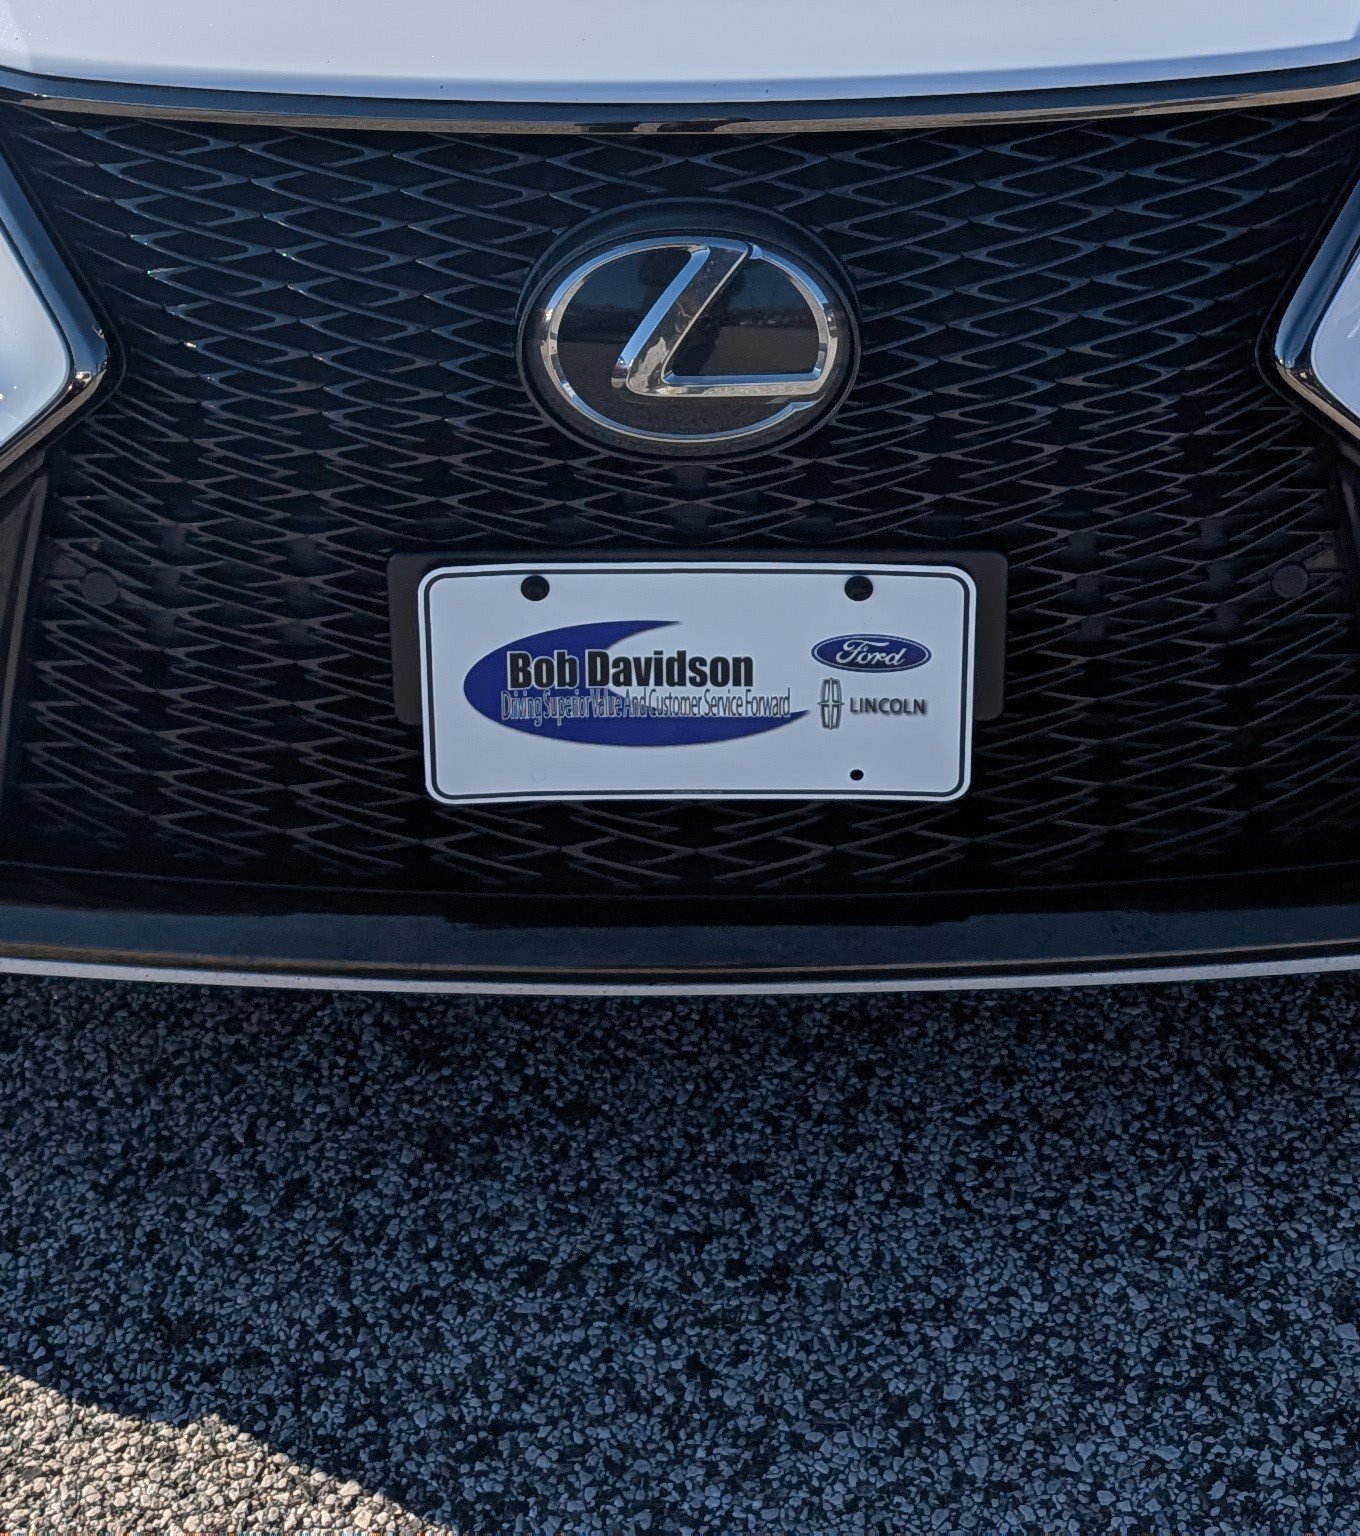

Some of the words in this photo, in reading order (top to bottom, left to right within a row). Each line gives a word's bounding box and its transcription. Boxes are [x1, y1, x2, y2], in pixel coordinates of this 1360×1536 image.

[835, 639, 908, 665] Ford
[507, 650, 579, 690] Bob
[585, 649, 754, 689] Davidson
[501, 690, 542, 727] Driving
[543, 689, 591, 727] Superior
[591, 688, 623, 718] Value
[623, 688, 647, 718] And
[649, 688, 703, 717] Customer
[704, 688, 744, 717] Service
[745, 687, 791, 717] Forward
[849, 697, 928, 716] LINCOLN
